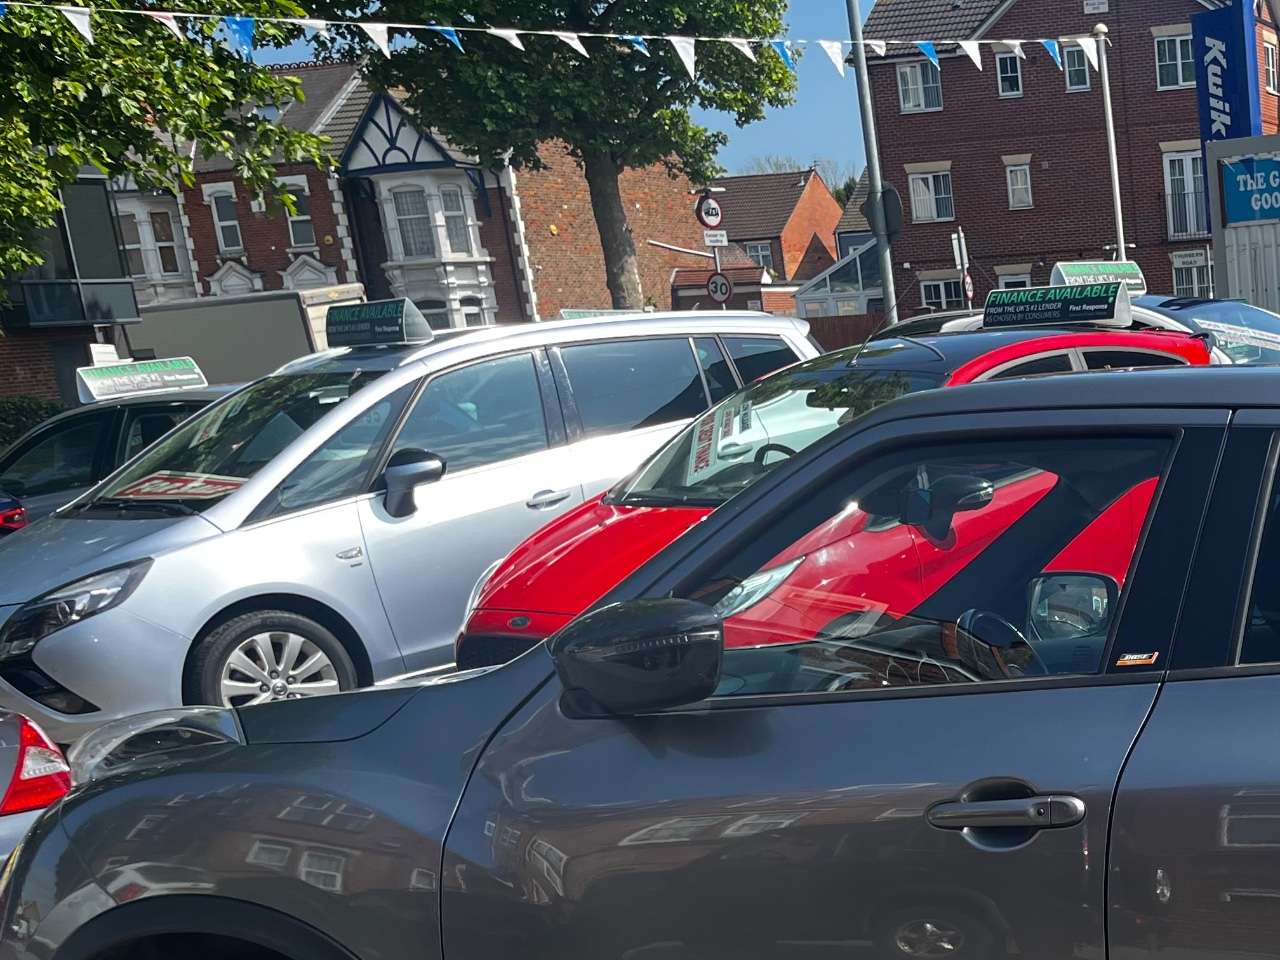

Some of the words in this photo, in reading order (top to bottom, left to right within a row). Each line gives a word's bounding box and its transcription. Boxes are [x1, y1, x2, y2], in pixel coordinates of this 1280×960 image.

[1204, 36, 1231, 137] Kwik
[1237, 171, 1267, 192] THE
[710, 281, 728, 295] 30
[989, 288, 1047, 305] FINANCE
[1047, 283, 1117, 301] AVAILABLE
[986, 306, 1003, 315] FROM
[1004, 305, 1016, 313] THE
[1038, 302, 1062, 311] LENDER
[1069, 304, 1082, 312] First
[1082, 303, 1108, 312] Response
